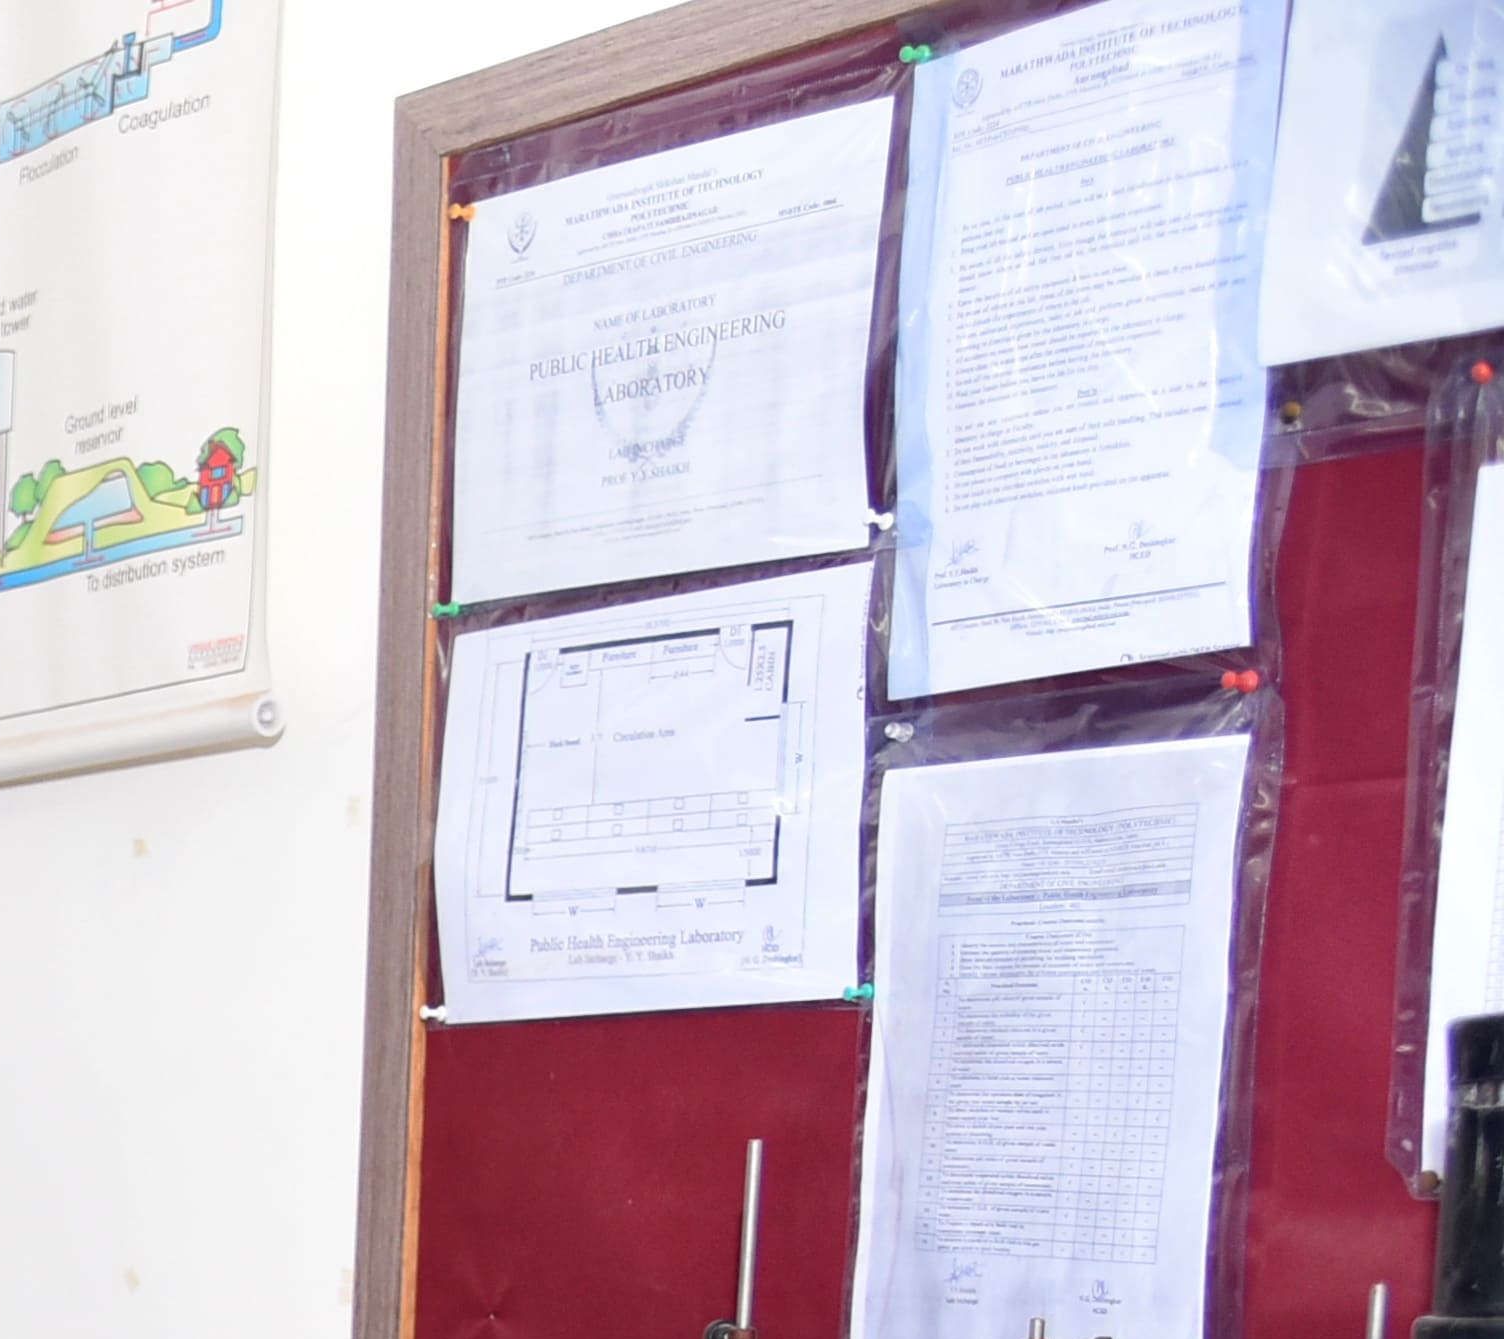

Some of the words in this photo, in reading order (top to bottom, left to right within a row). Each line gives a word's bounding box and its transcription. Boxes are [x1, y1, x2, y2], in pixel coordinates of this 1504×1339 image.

[593, 315, 624, 331] NAME
[625, 311, 639, 324] OF
[642, 294, 716, 320] LABORATORY
[529, 352, 588, 381] PUBLIC
[591, 336, 660, 367] HEALTH
[664, 310, 786, 352] ENGINEERING
[593, 366, 710, 407] LABORATORY
